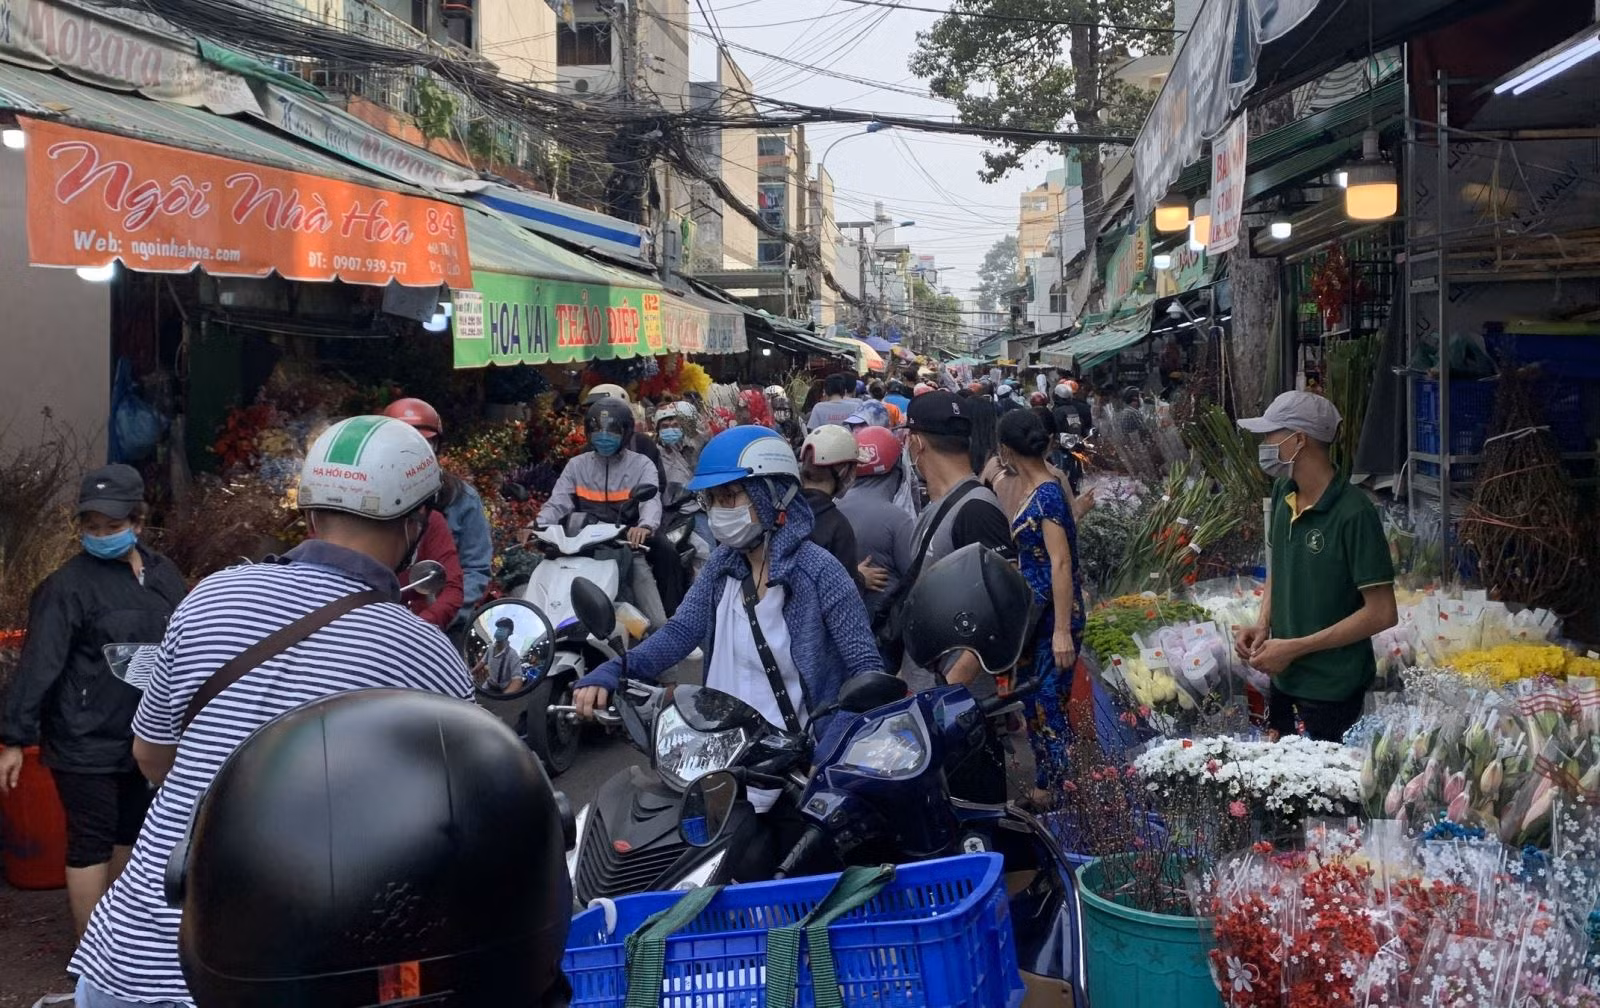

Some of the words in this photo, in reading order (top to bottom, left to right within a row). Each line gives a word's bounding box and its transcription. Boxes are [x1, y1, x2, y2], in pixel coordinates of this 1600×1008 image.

[48, 141, 212, 232] Ngôi
[225, 172, 333, 234] Nhà
[340, 199, 414, 244] Hoa
[427, 208, 457, 239] 84
[74, 229, 122, 252] Web:
[131, 237, 241, 261] ngoinhahoa.com
[333, 255, 407, 274] 0907.939.577
[489, 302, 521, 355] HOA
[555, 289, 602, 347] THẢO
